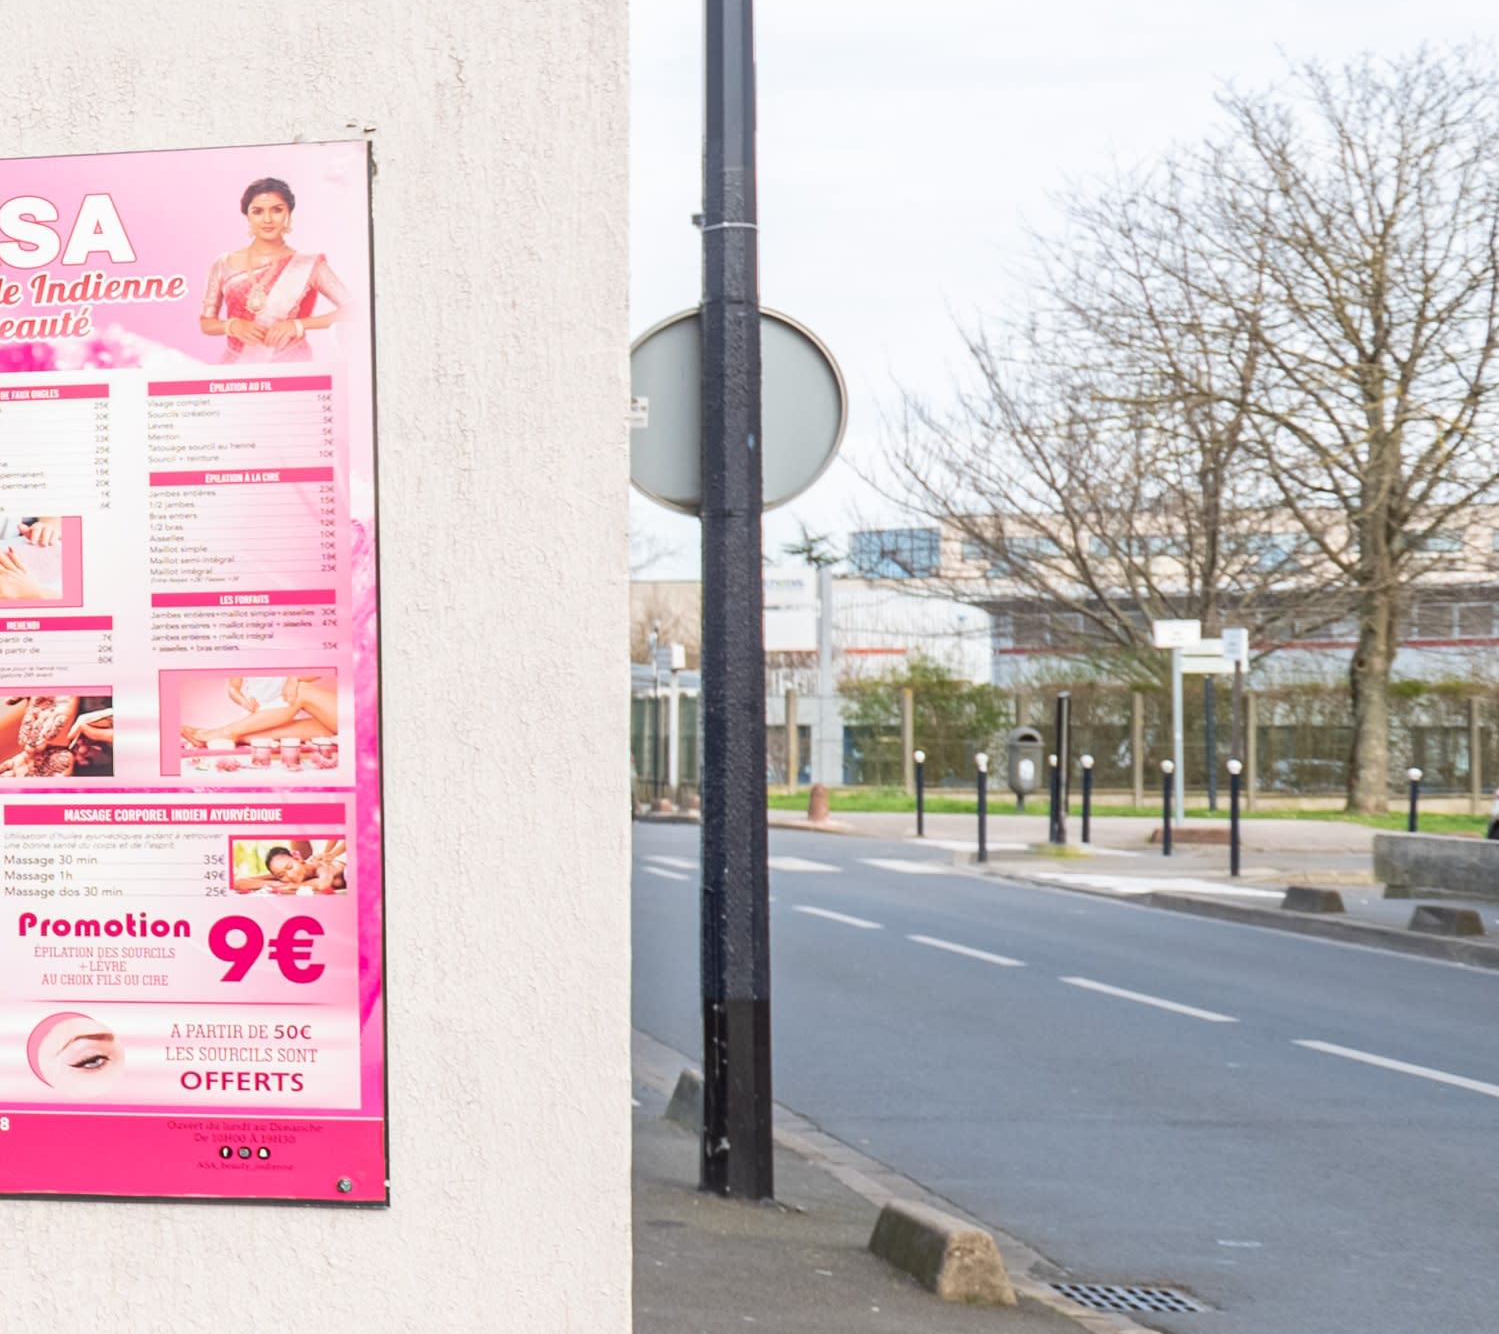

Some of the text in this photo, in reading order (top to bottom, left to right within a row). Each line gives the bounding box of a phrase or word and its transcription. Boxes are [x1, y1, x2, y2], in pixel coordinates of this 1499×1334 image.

[30, 269, 189, 305] Indienne
[64, 807, 282, 821] MASSAGE CORPOREL INDIEN AYURVÉDIQUE
[19, 912, 325, 984] Promotion 9€
[186, 1024, 243, 1039] PARTIR
[249, 1025, 268, 1039] DE
[274, 1025, 312, 1040] 50€
[165, 1047, 317, 1063] LES SOURCILS SONT
[181, 1071, 304, 1092] OFFERTS
